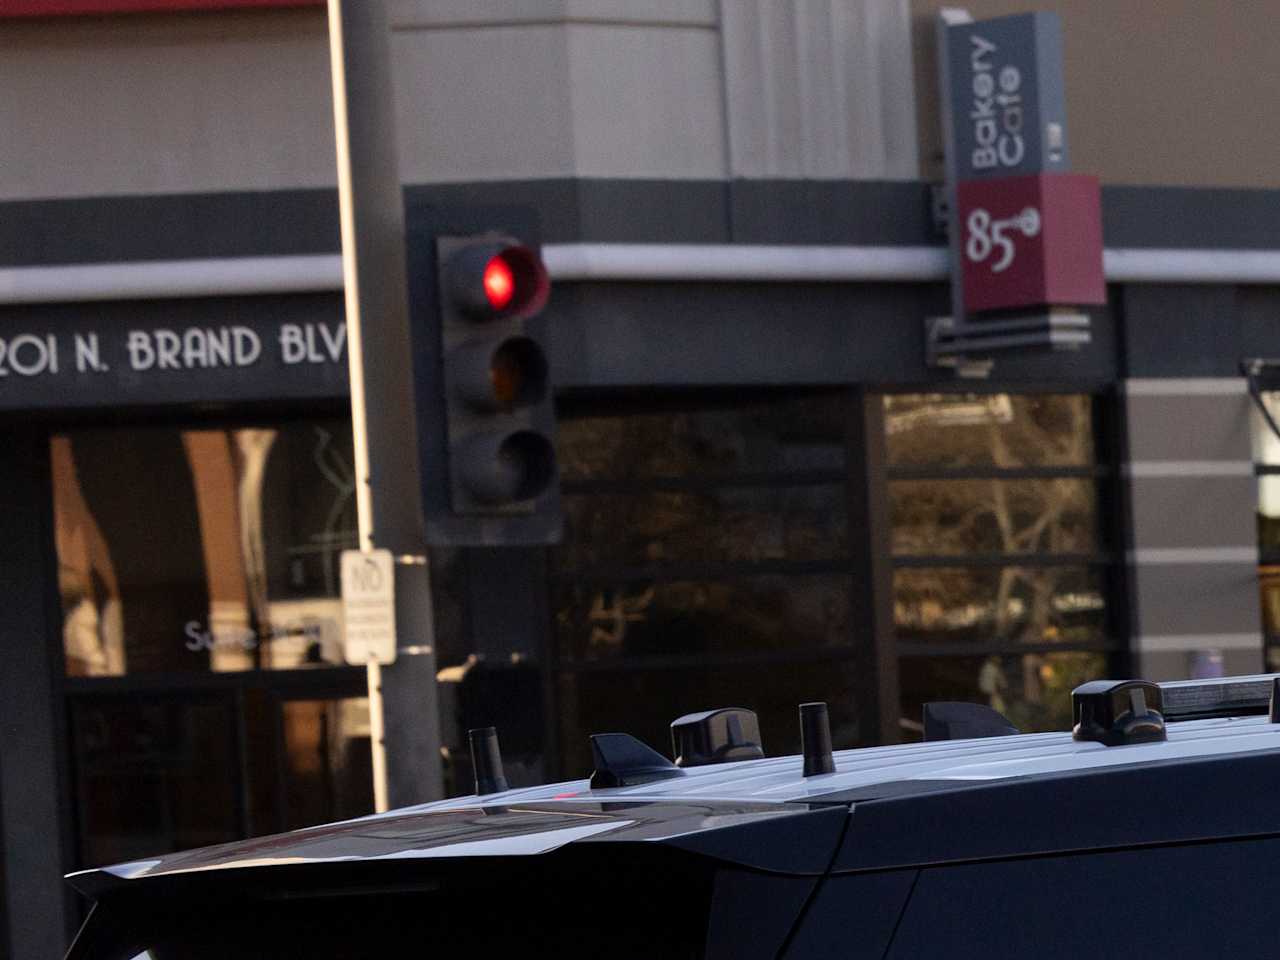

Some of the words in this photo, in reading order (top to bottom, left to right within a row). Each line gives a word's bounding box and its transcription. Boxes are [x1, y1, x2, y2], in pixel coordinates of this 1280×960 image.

[970, 35, 998, 169] Bakery
[75, 332, 110, 373] N.
[127, 325, 262, 371] BRAND
[279, 322, 348, 365] BLV
